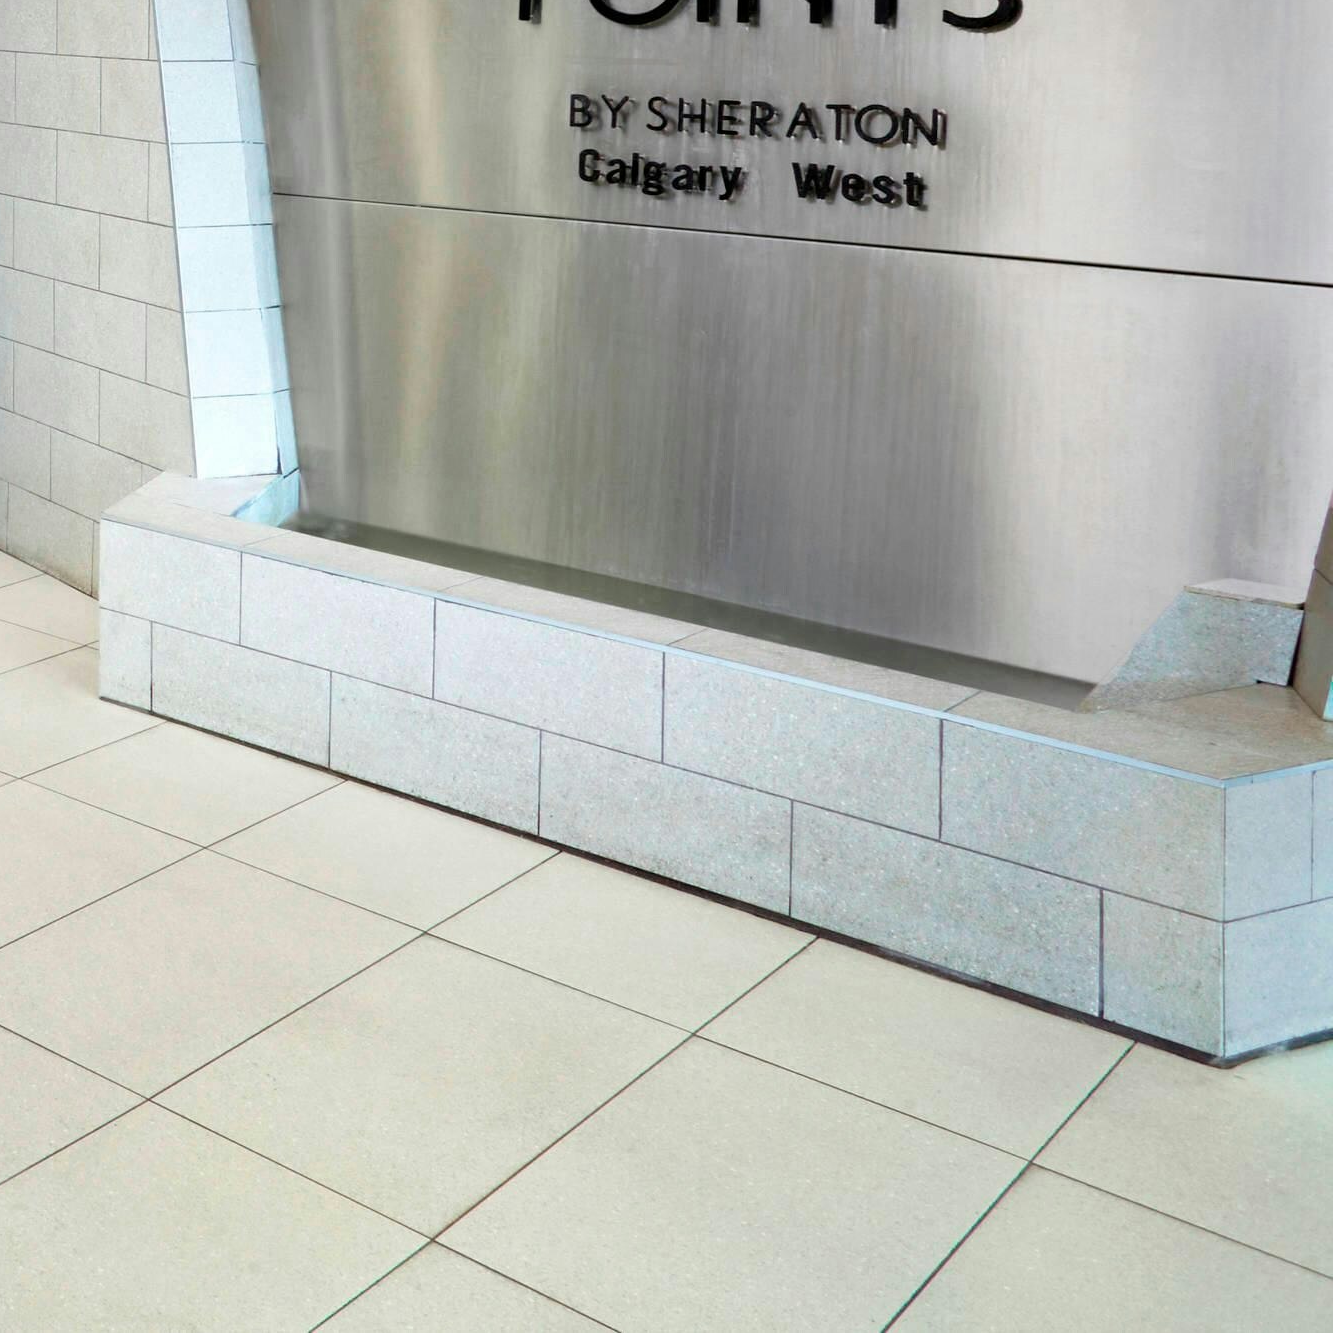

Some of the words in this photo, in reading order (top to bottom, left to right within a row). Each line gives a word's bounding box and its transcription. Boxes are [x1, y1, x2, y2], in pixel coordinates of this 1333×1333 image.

[569, 94, 630, 129] BY
[646, 96, 946, 147] SHERATON
[578, 149, 744, 201] Calgary
[791, 162, 927, 208] West
